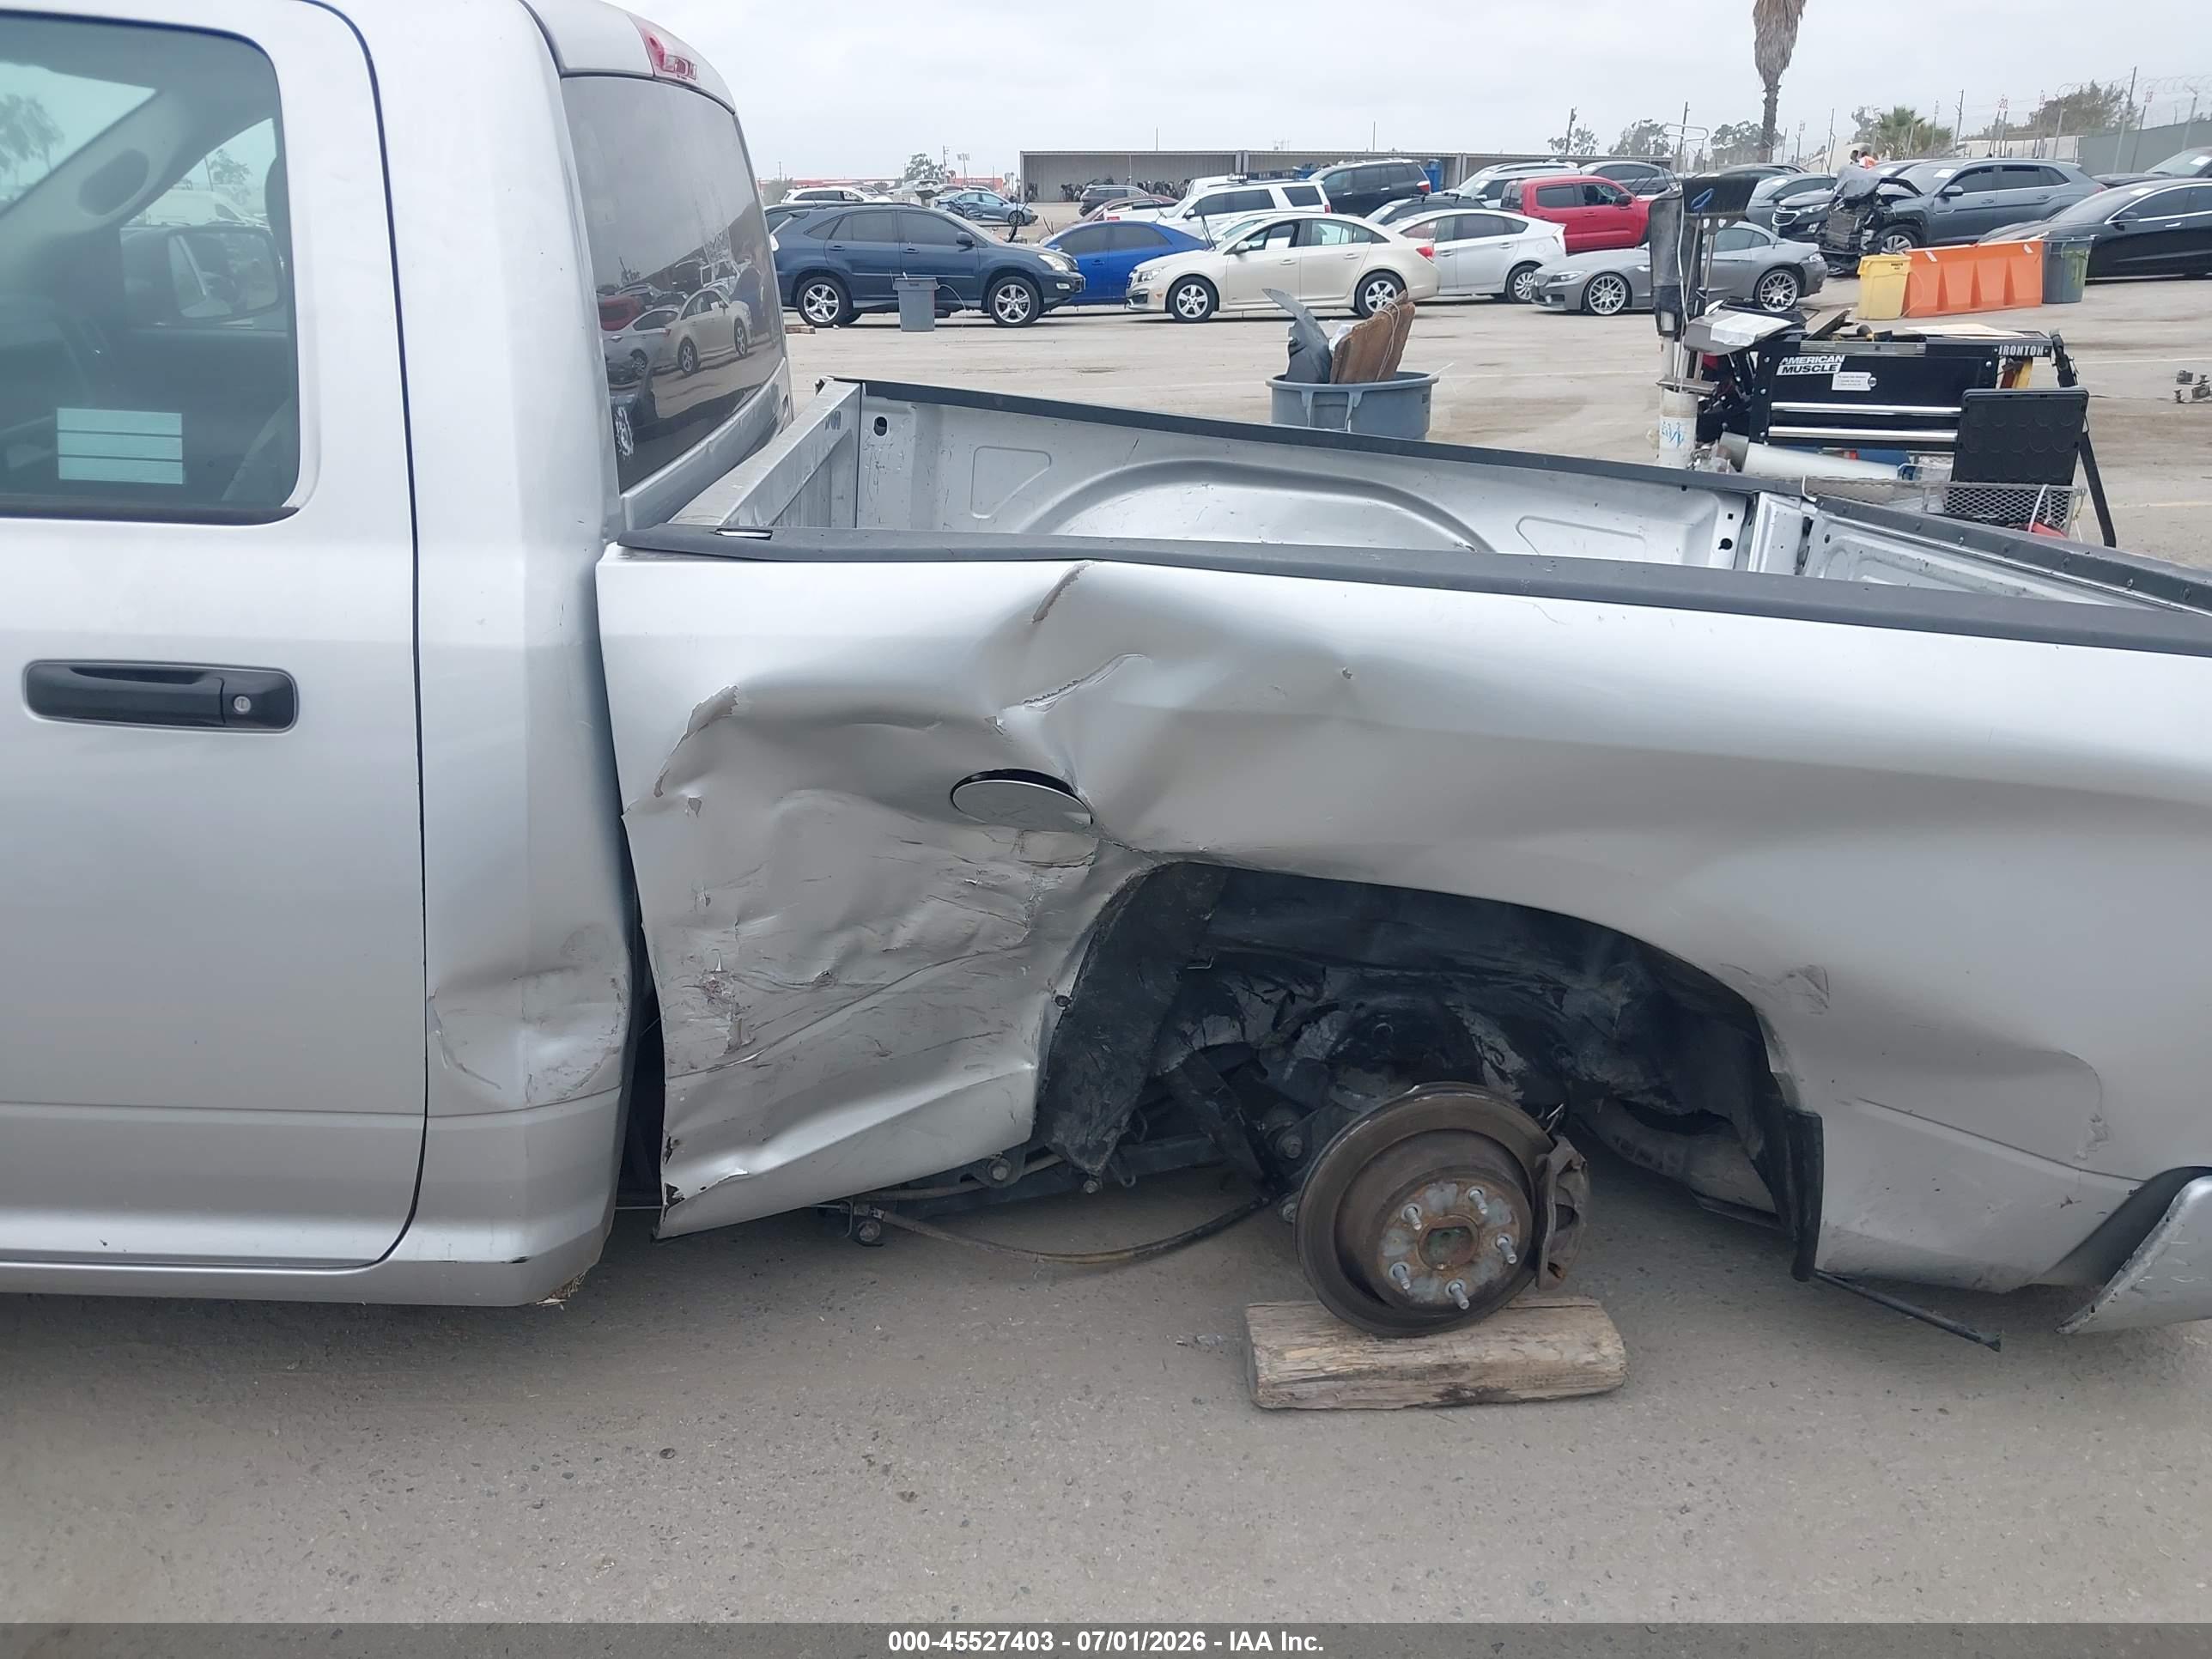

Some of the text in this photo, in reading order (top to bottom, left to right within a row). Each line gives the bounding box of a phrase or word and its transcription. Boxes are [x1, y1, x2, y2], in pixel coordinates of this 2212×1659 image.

[1998, 98, 2008, 109] 20
[1998, 345, 2045, 356] IRONTON
[1779, 355, 1845, 365] AMERICAN
[1781, 364, 1838, 374] MUSCLE
